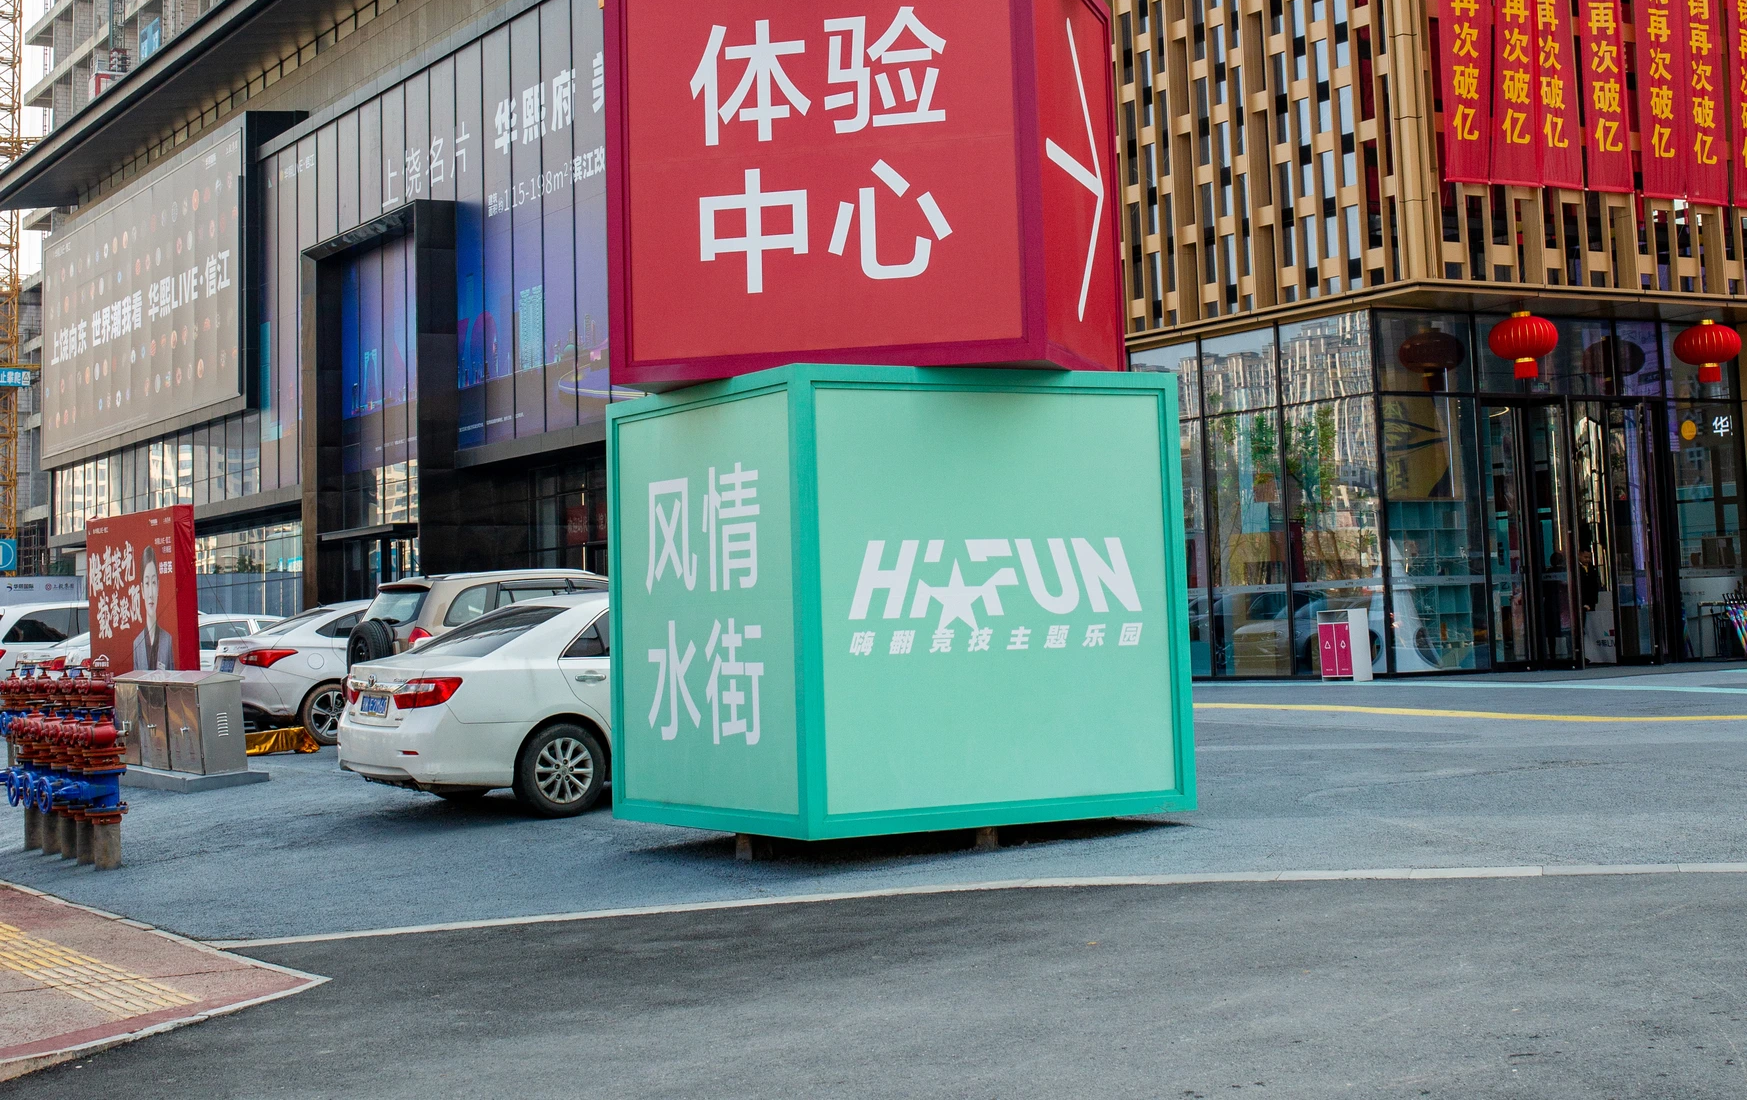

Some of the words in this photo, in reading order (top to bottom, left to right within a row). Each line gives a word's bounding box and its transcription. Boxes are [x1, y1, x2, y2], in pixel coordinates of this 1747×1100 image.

[382, 121, 470, 208] 上饶名片
[494, 68, 576, 155] 华熙府
[690, 6, 946, 146] 体验
[699, 159, 952, 294] 中心
[50, 317, 88, 366] 上饶向东
[91, 290, 142, 349] 世界潮我看
[646, 462, 760, 595] 风情
[646, 618, 764, 746] 水街
[849, 622, 1143, 656] 嗨翻竞技主题乐园
